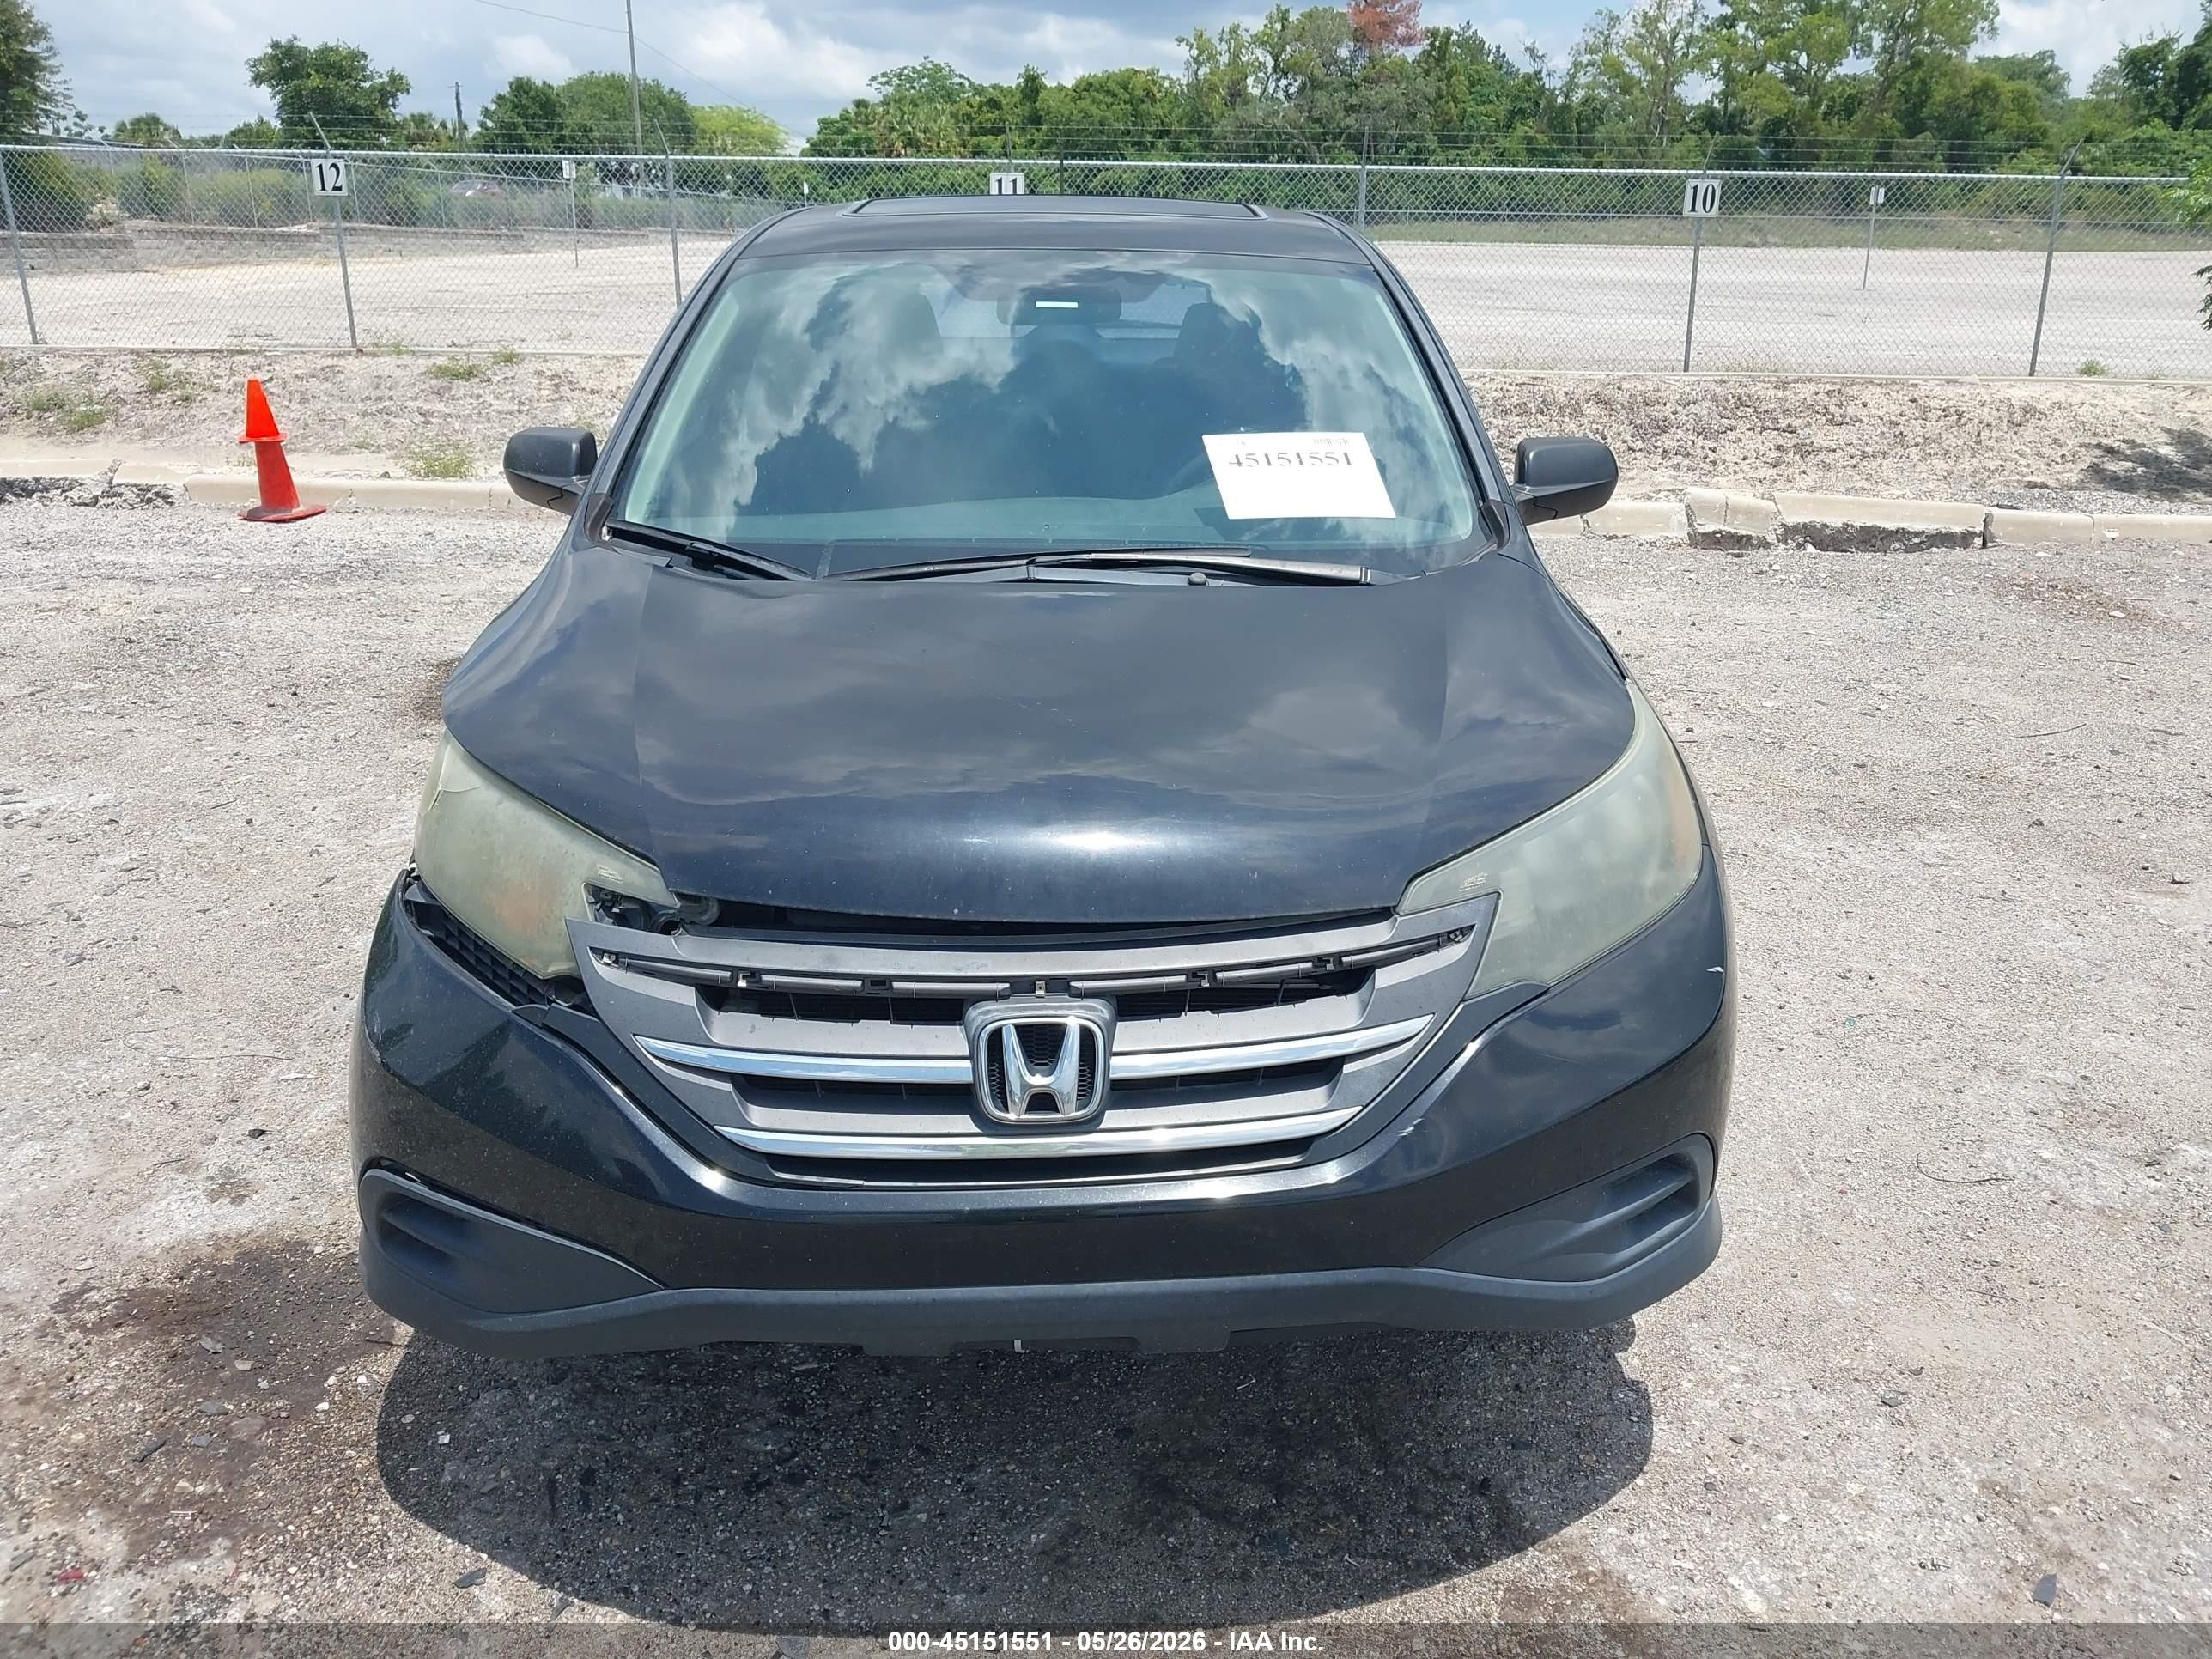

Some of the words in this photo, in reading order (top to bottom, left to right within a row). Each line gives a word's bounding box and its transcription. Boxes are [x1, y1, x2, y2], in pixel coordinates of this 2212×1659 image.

[315, 161, 343, 192] 12
[994, 177, 1018, 195] 11
[1687, 183, 1717, 213] 10
[1228, 451, 1352, 467] 45151551
